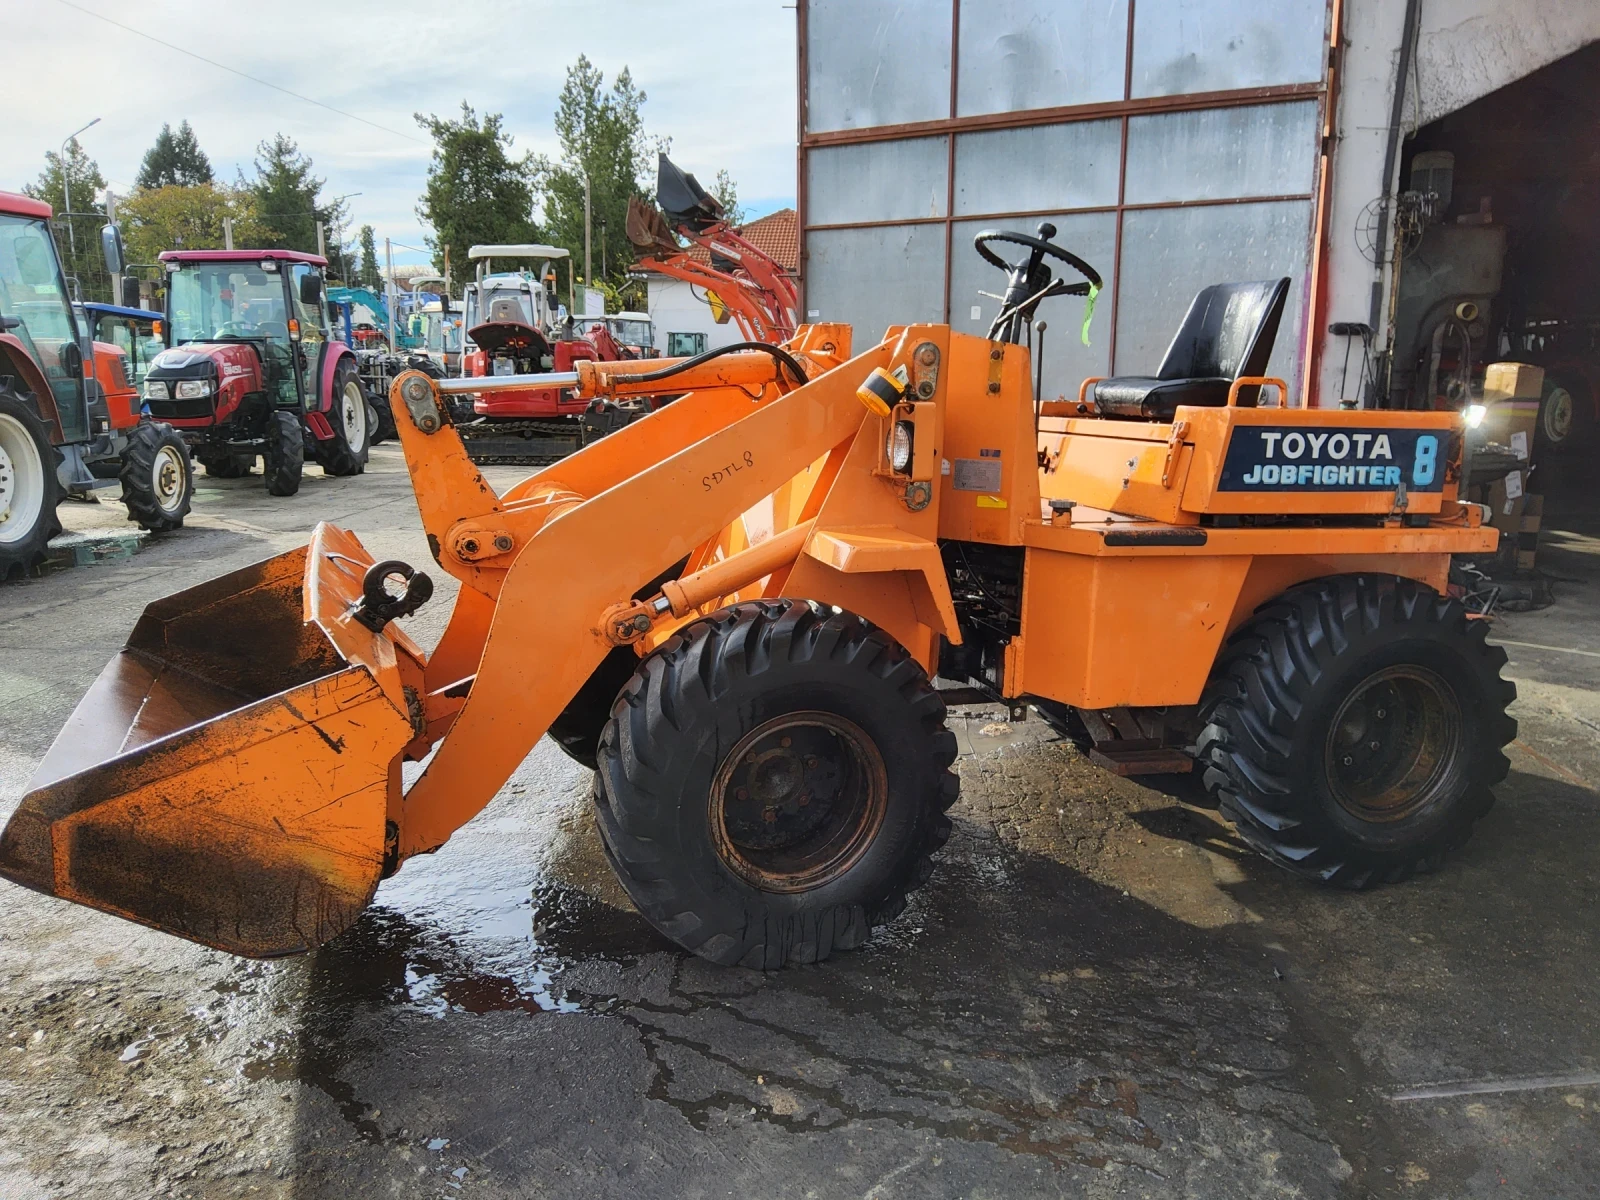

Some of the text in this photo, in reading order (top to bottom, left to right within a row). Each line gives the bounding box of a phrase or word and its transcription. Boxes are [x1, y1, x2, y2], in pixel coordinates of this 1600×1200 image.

[1260, 432, 1393, 460] TOYOTA
[1243, 464, 1401, 485] JOBFIGHTER
[1412, 435, 1438, 486] 8
